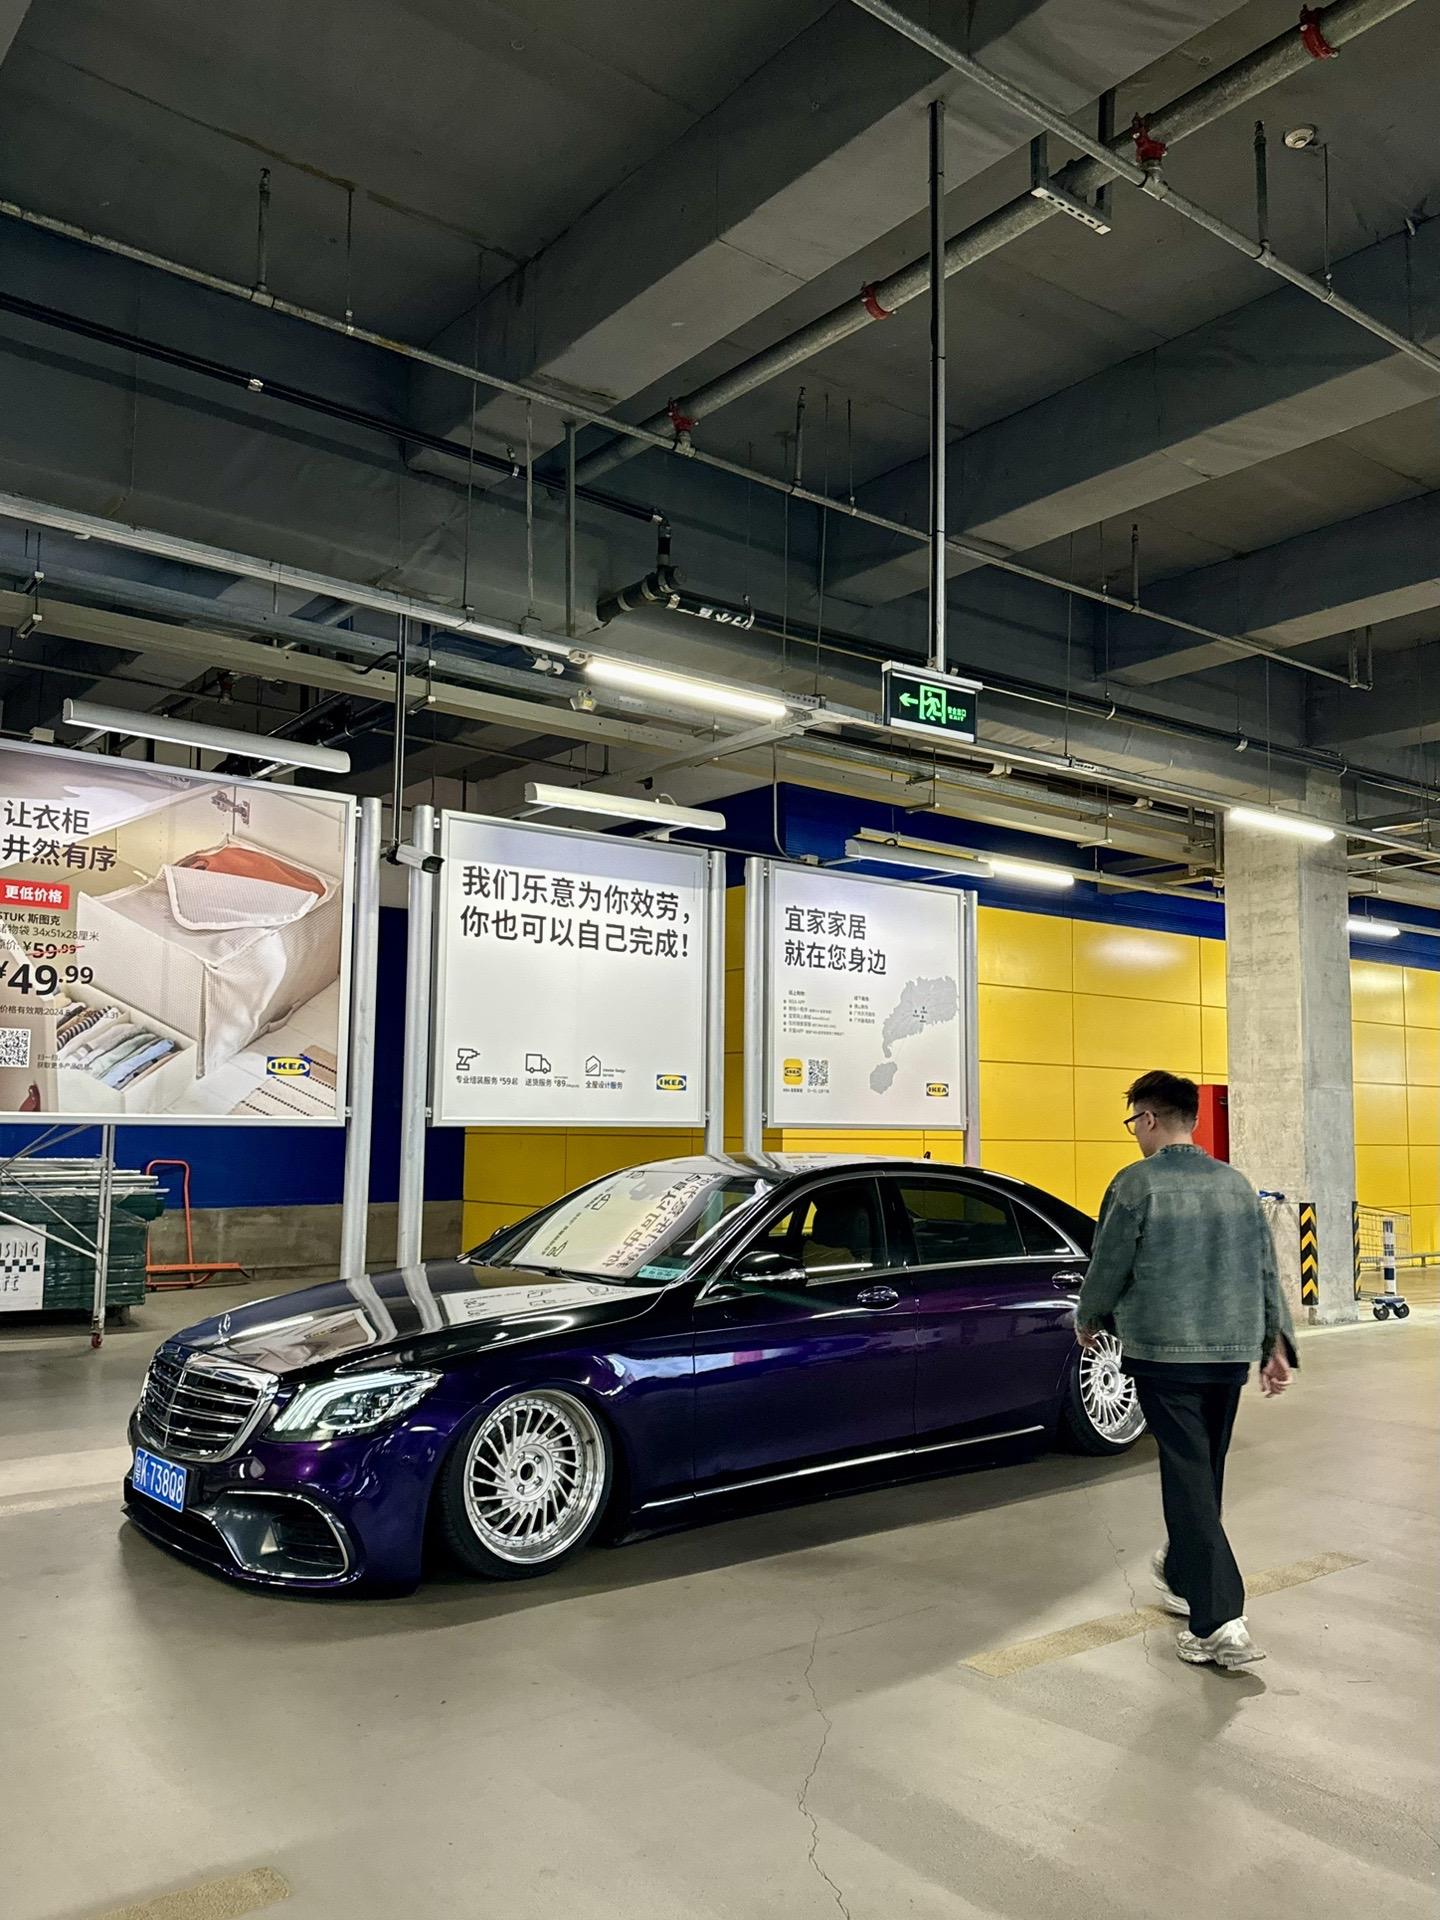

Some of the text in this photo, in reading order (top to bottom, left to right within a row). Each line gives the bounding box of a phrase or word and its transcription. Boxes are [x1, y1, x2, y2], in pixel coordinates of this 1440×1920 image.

[4, 800, 90, 835] 让衣柜
[2, 834, 117, 872] 井然有序
[5, 884, 62, 904] 更低价格
[28, 914, 61, 926] 斯图克
[784, 904, 866, 941] 宜家家居
[784, 938, 887, 976] 就在您身边
[271, 1061, 306, 1070] IKEA
[659, 1078, 684, 1087] IKEA
[0, 1241, 39, 1259] SING
